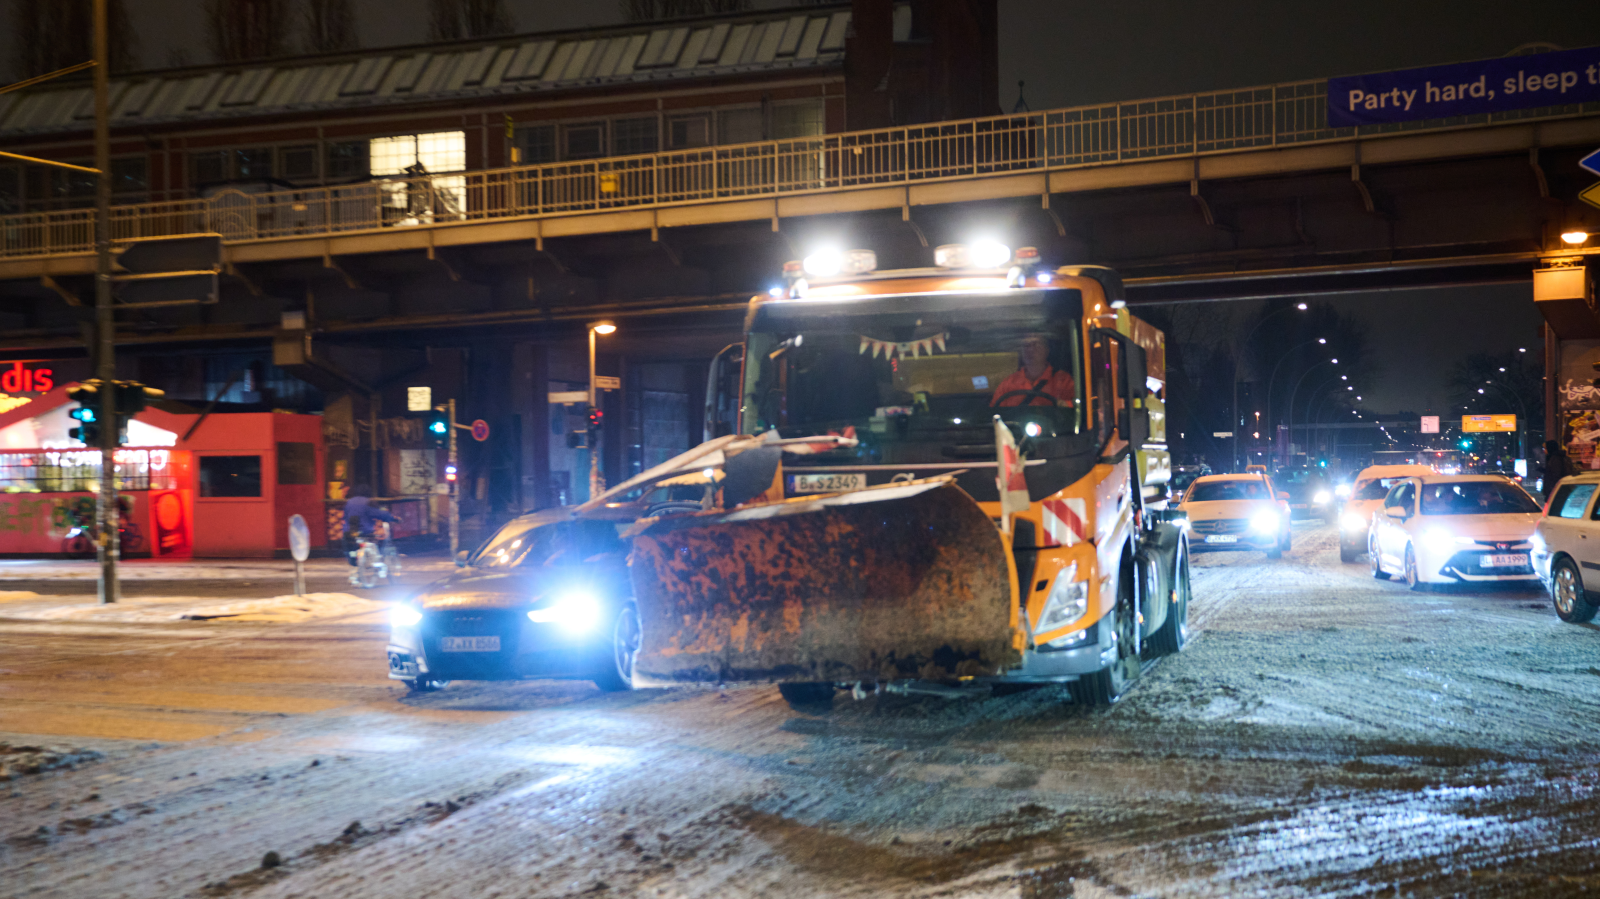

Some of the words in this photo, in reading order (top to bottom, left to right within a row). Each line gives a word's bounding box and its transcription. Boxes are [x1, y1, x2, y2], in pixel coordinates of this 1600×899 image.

[1349, 88, 1417, 111] Party
[1425, 75, 1496, 103] hard,
[1503, 70, 1578, 94] sleep
